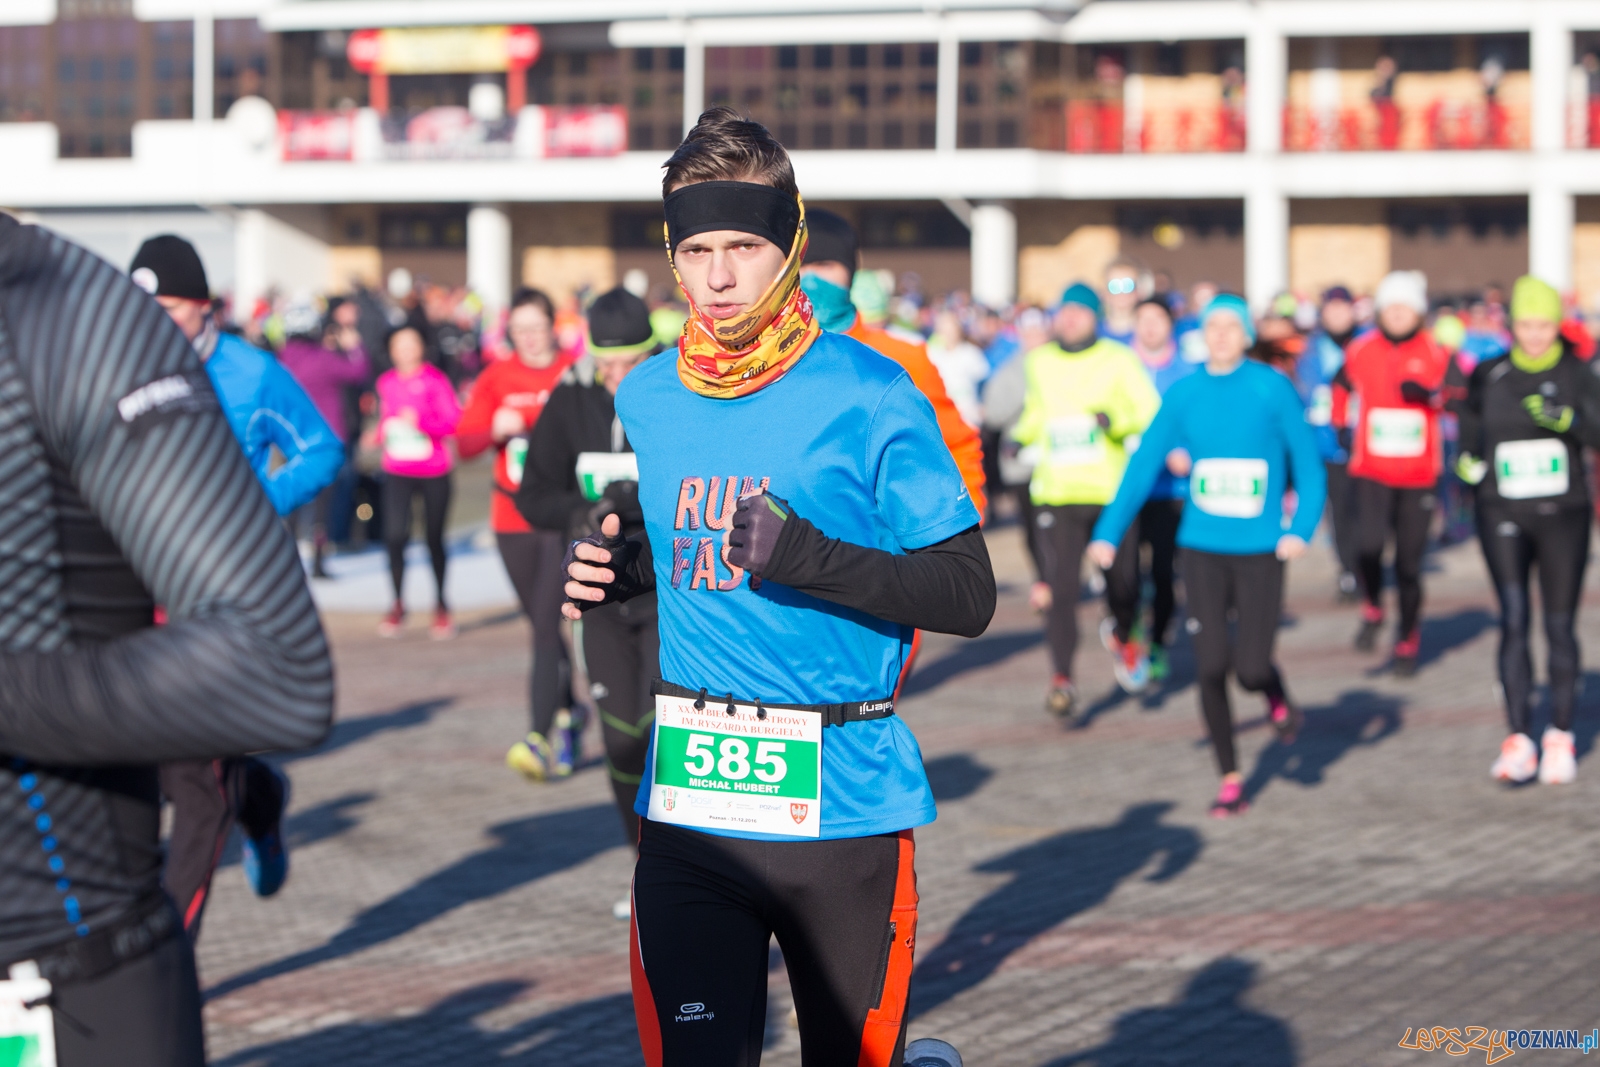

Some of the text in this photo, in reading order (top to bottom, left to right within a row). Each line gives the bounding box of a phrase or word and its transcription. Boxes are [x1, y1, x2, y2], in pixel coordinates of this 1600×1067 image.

[672, 537, 762, 592] FAS
[706, 708, 729, 719] BIEG
[681, 716, 803, 737] IM. RYSZARDA BURGIELA
[683, 733, 788, 783] 585
[688, 777, 780, 794] MICHAŁ HUBERT
[675, 1011, 715, 1023] Kalenji
